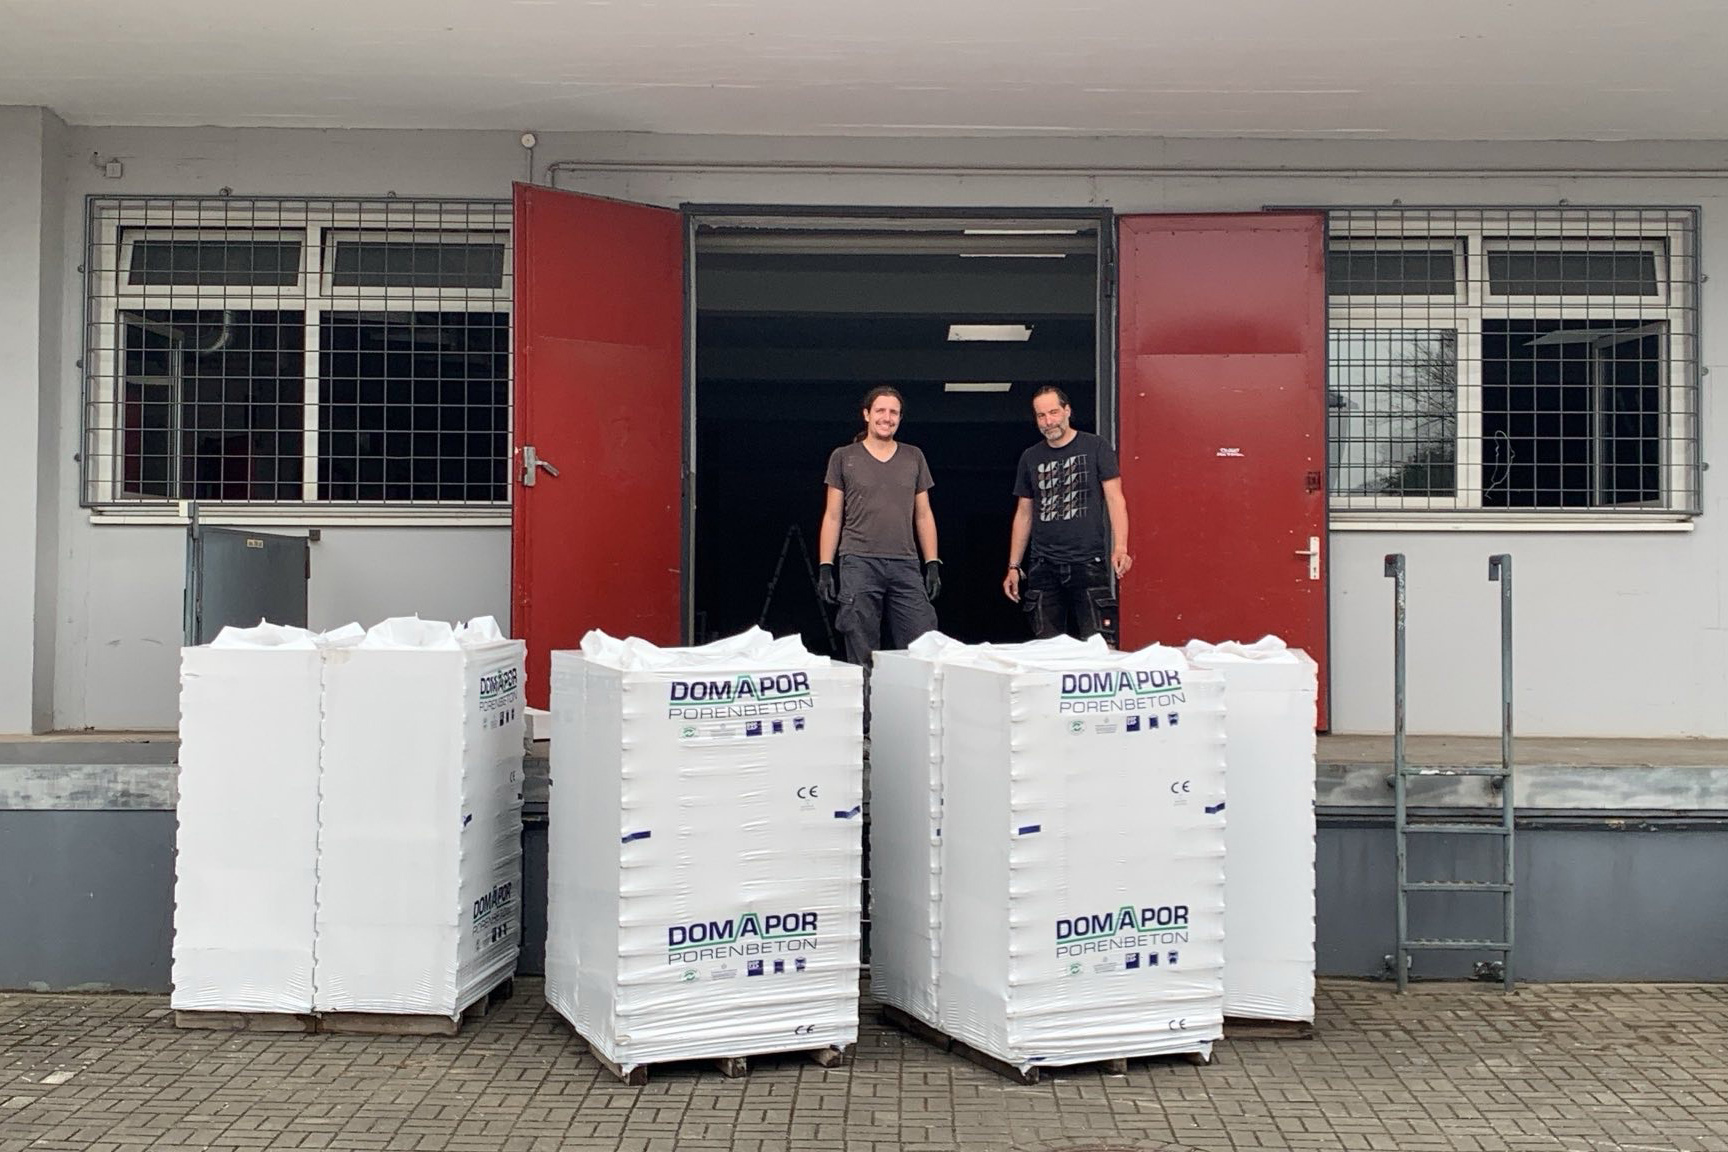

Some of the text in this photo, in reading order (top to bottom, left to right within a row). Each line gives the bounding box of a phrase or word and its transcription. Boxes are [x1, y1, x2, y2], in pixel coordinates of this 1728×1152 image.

[670, 672, 810, 701] DOMAPOR
[1062, 670, 1181, 694] DOMAPOR
[669, 698, 814, 720] PORENBETON
[1060, 692, 1186, 713] PORENBETON
[668, 912, 818, 946] DOMAPOR
[1056, 905, 1189, 940] DOMAPOR
[668, 938, 818, 965] PORENBETON
[1056, 931, 1189, 958] PORENBETON
